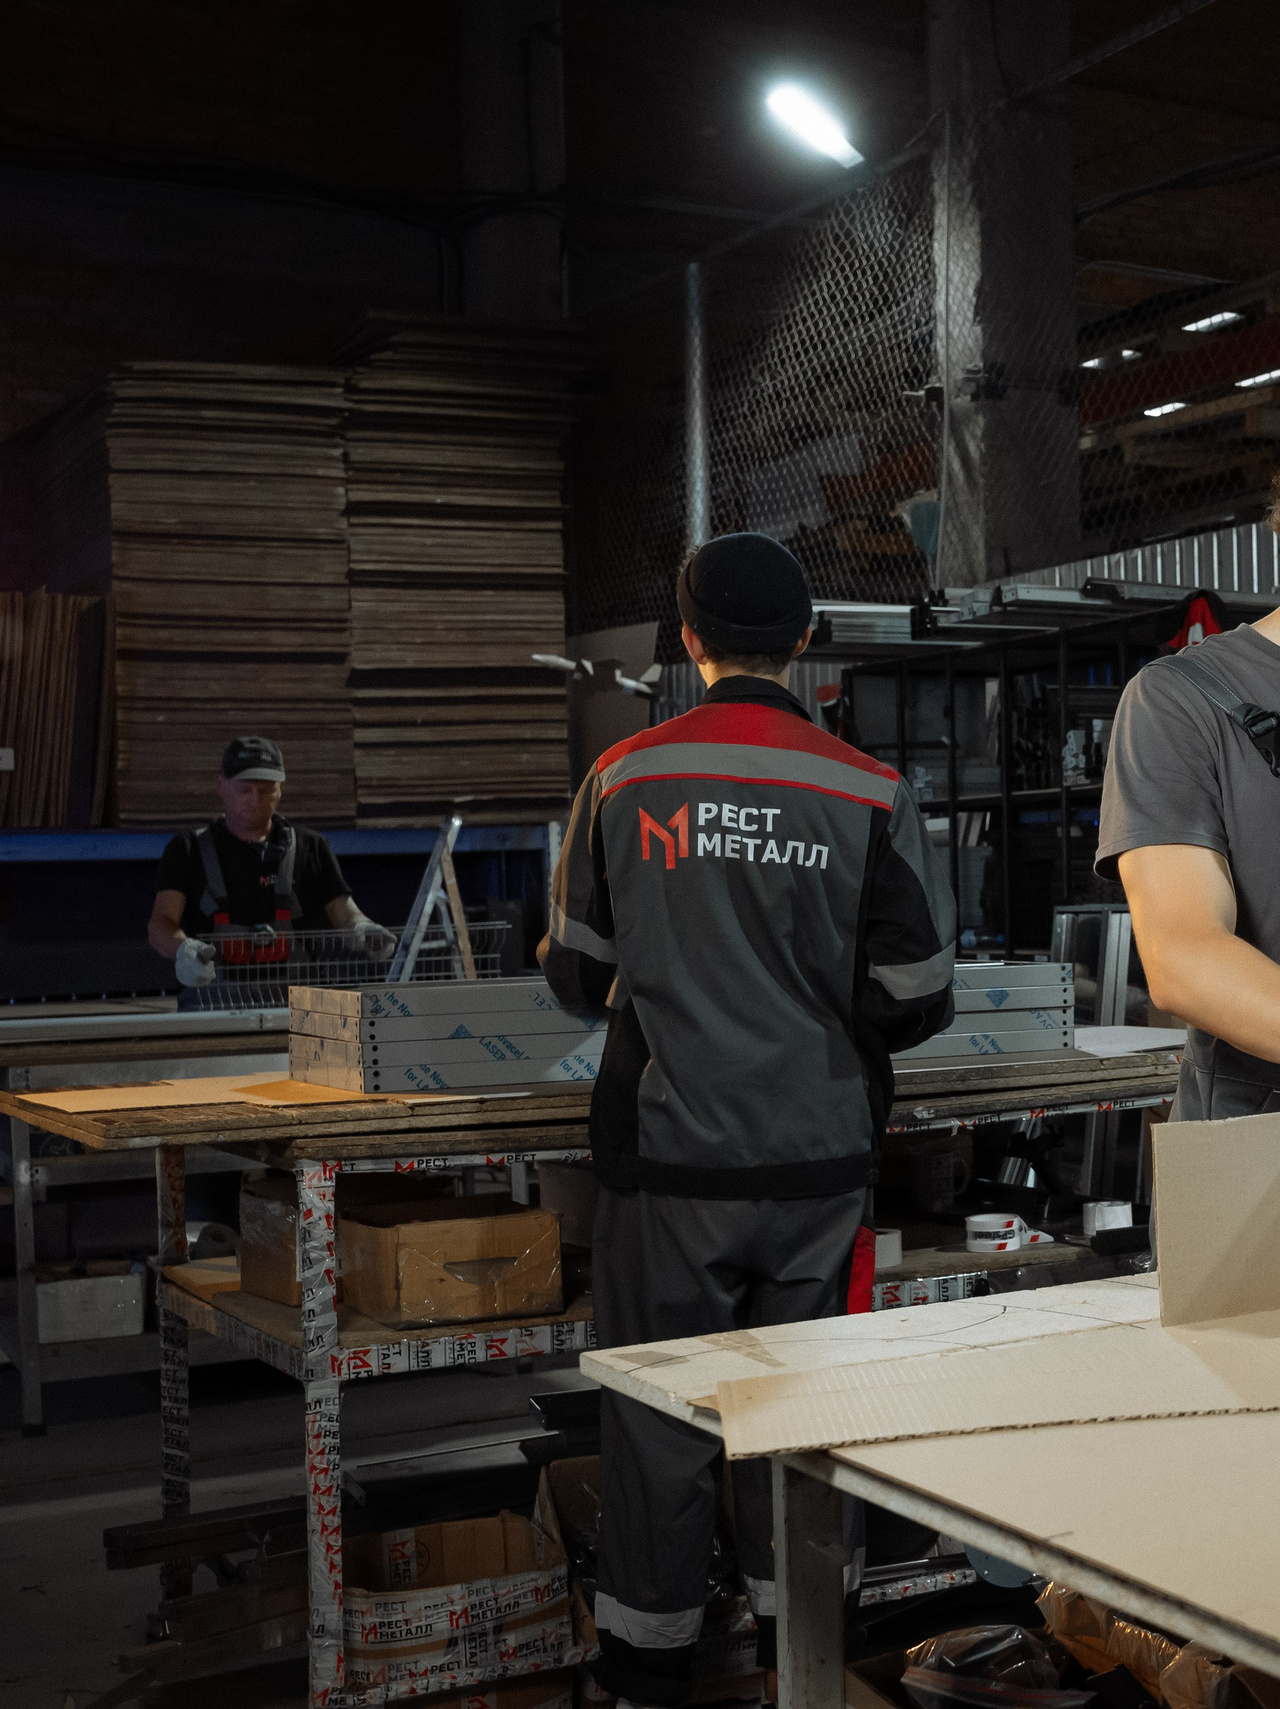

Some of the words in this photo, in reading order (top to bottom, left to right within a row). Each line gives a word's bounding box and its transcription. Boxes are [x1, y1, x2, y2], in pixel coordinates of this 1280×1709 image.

[697, 802, 781, 833] РЕСТ
[697, 832, 829, 870] МЕТАЛЛ
[416, 1157, 449, 1169] РЕСТ
[470, 1597, 499, 1613] РЕСТ
[470, 1601, 520, 1623] МЕТАЛЛ
[378, 1619, 410, 1630] РЕСТ
[379, 1624, 433, 1640] МЕТАЛЛ
[430, 1660, 461, 1674] РЕСТ
